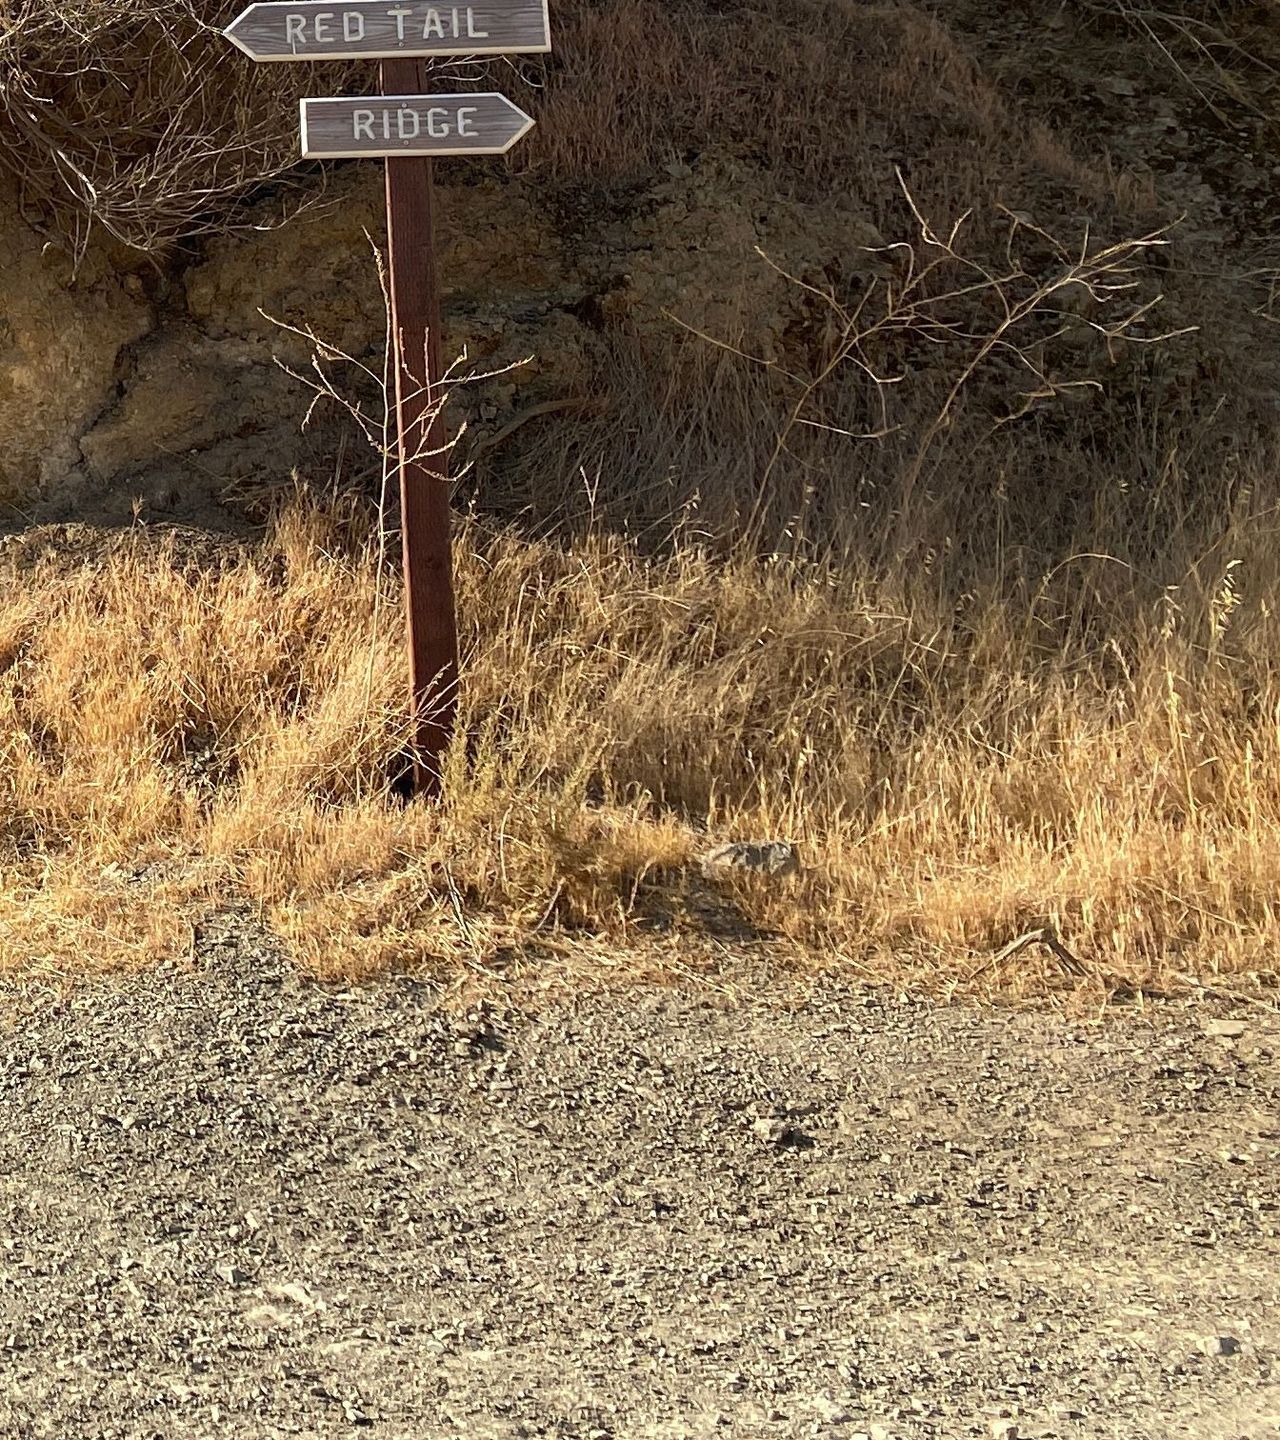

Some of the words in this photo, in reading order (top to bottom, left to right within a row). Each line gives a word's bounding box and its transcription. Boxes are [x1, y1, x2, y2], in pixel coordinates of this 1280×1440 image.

[285, 11, 365, 44] RED
[386, 6, 489, 41] TAIL
[352, 106, 479, 141] RIDGE
